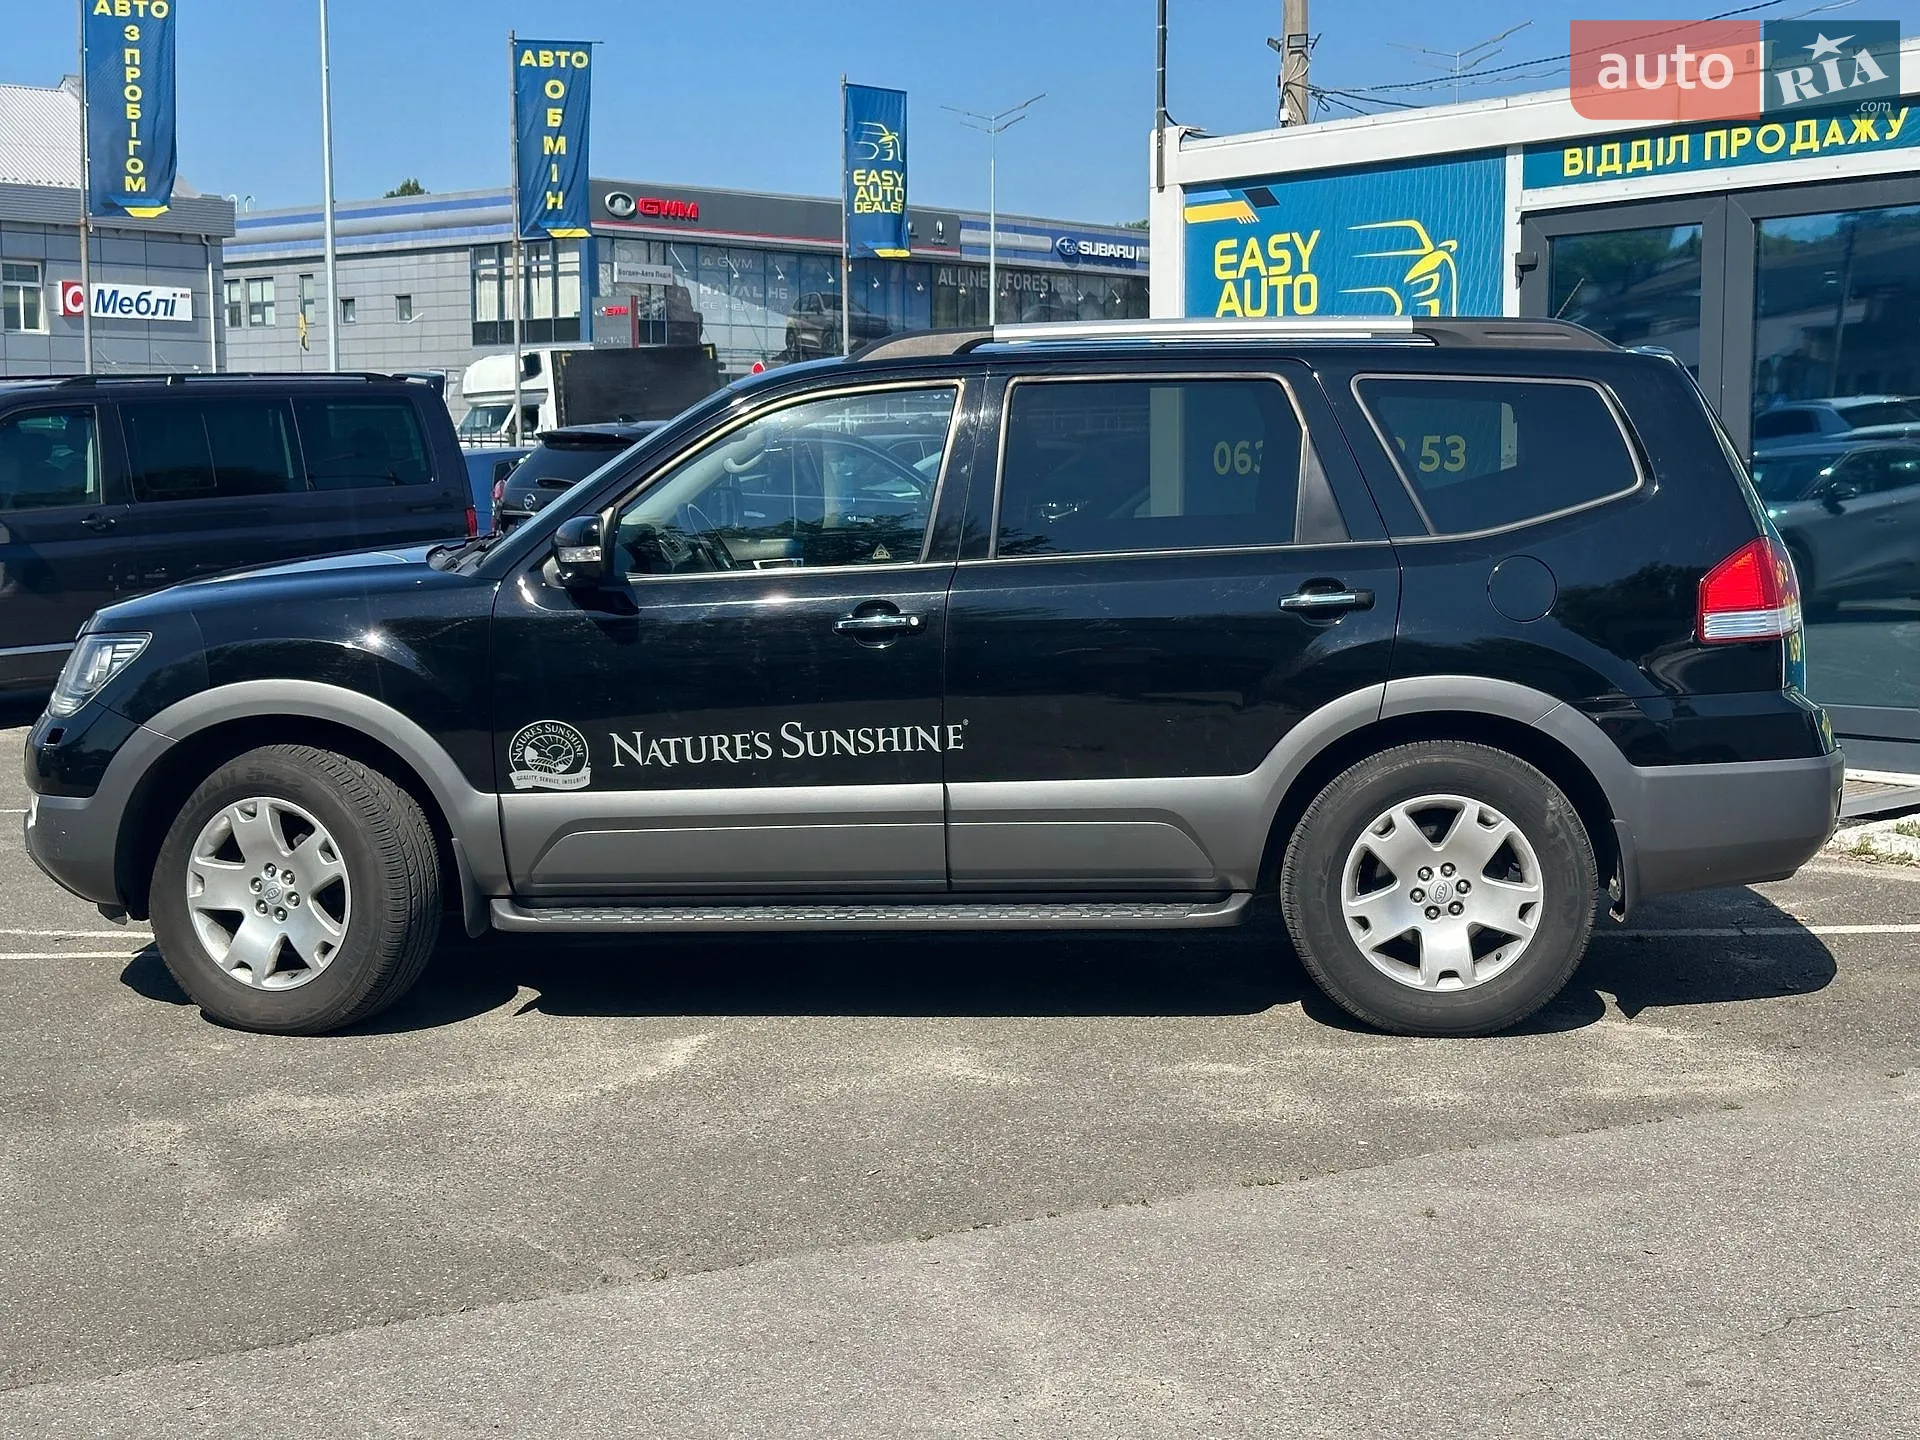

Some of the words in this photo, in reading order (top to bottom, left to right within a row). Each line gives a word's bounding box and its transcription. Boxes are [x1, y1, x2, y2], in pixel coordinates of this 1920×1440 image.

[93, 0, 169, 18] АВТО
[124, 25, 140, 41] З
[520, 50, 589, 69] АВТО
[124, 48, 147, 192] ПРОБІГОМ
[543, 79, 567, 210] ОБМІН
[1563, 134, 1690, 177] ВІДДІЛ
[1704, 107, 1909, 161] ПРОДАЖУ
[853, 169, 904, 186] EASY
[638, 196, 699, 219] GWM
[854, 185, 905, 203] AUTO
[854, 201, 903, 214] DEALER
[1078, 240, 1135, 259] SUBARU
[1214, 230, 1320, 280] EASY
[95, 289, 177, 317] Меблі
[1215, 273, 1318, 318] AUTO
[1419, 434, 1466, 472] 53
[544, 723, 584, 757] SUNSHINE
[609, 730, 773, 767] NATURE'S
[780, 721, 964, 759] SUNSHINE
